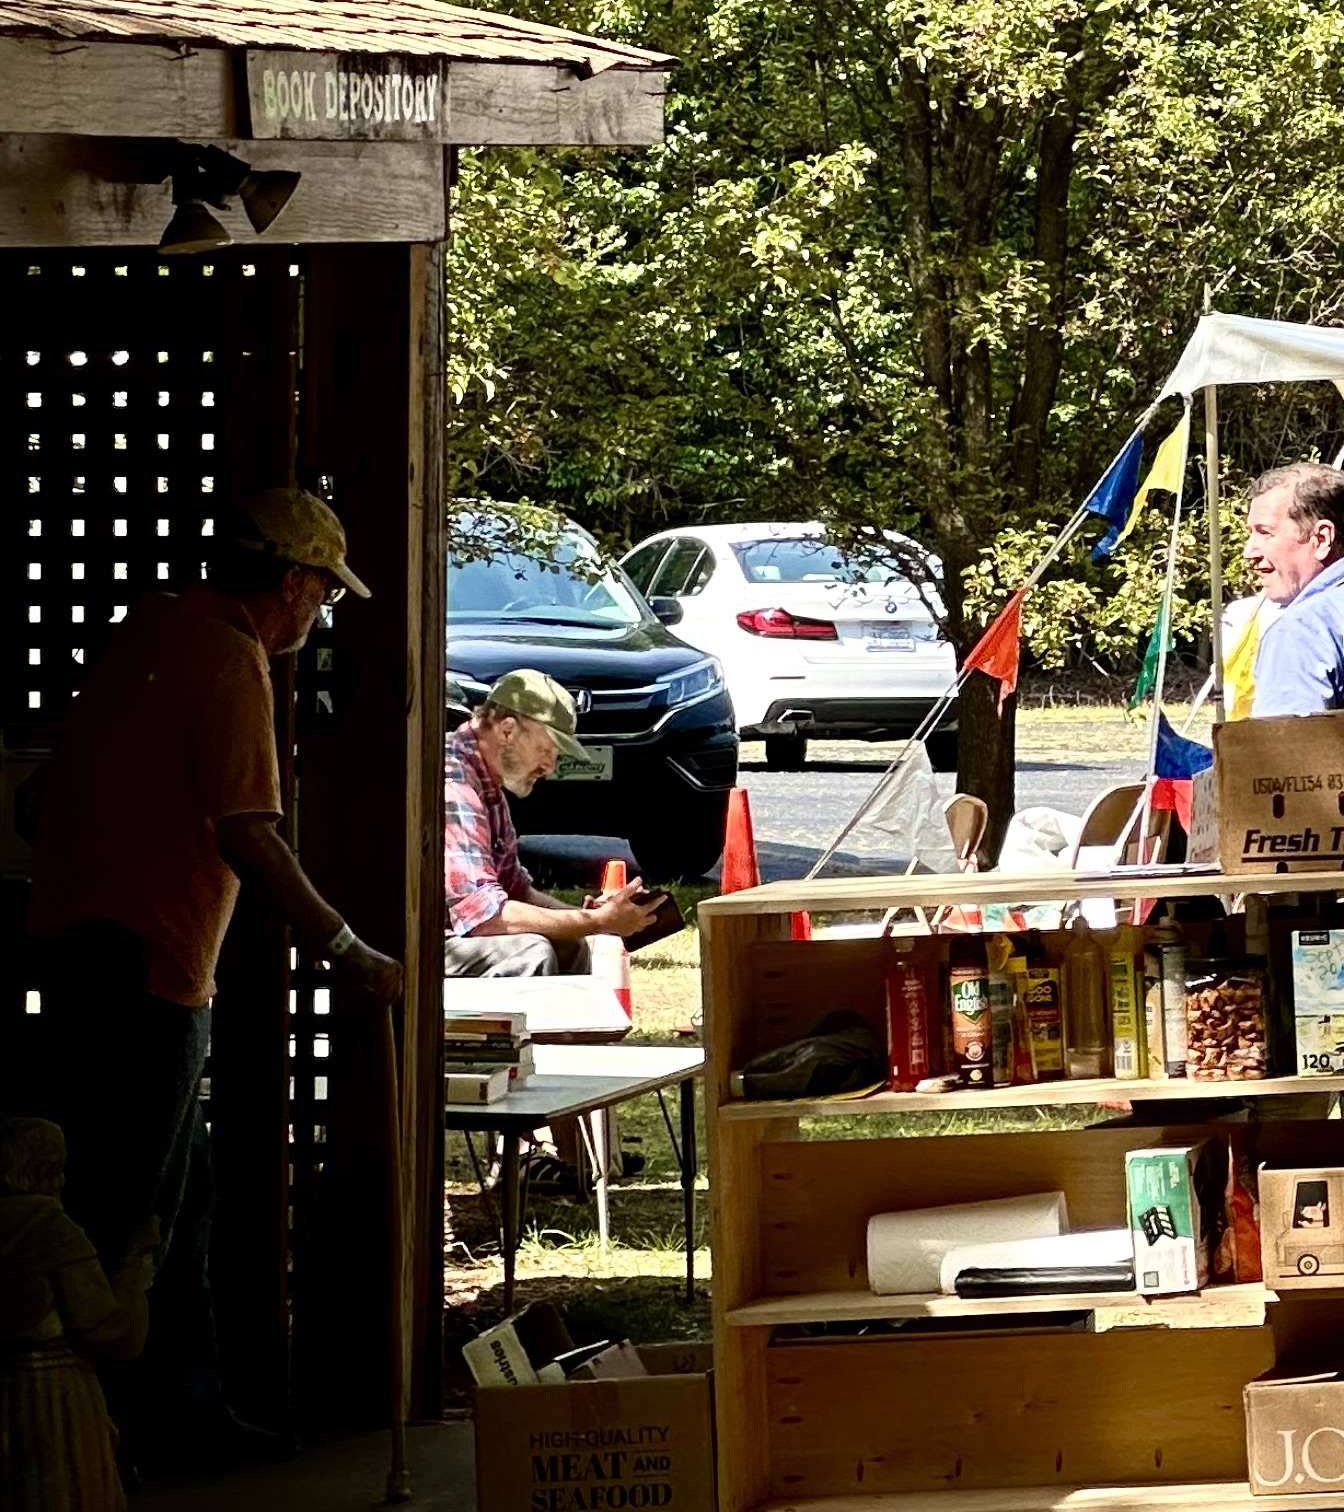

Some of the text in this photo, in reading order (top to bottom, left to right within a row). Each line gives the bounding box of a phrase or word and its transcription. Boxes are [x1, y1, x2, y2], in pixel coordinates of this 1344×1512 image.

[263, 69, 438, 123] BOOK DEPOSITORY
[1242, 827, 1320, 854] Fresh
[961, 980, 981, 999] Old
[1302, 1053, 1330, 1069] 120
[529, 1426, 670, 1450] HIGH QUALITY
[530, 1451, 672, 1484] MEAT AND
[530, 1482, 673, 1512] SEAFOOD
